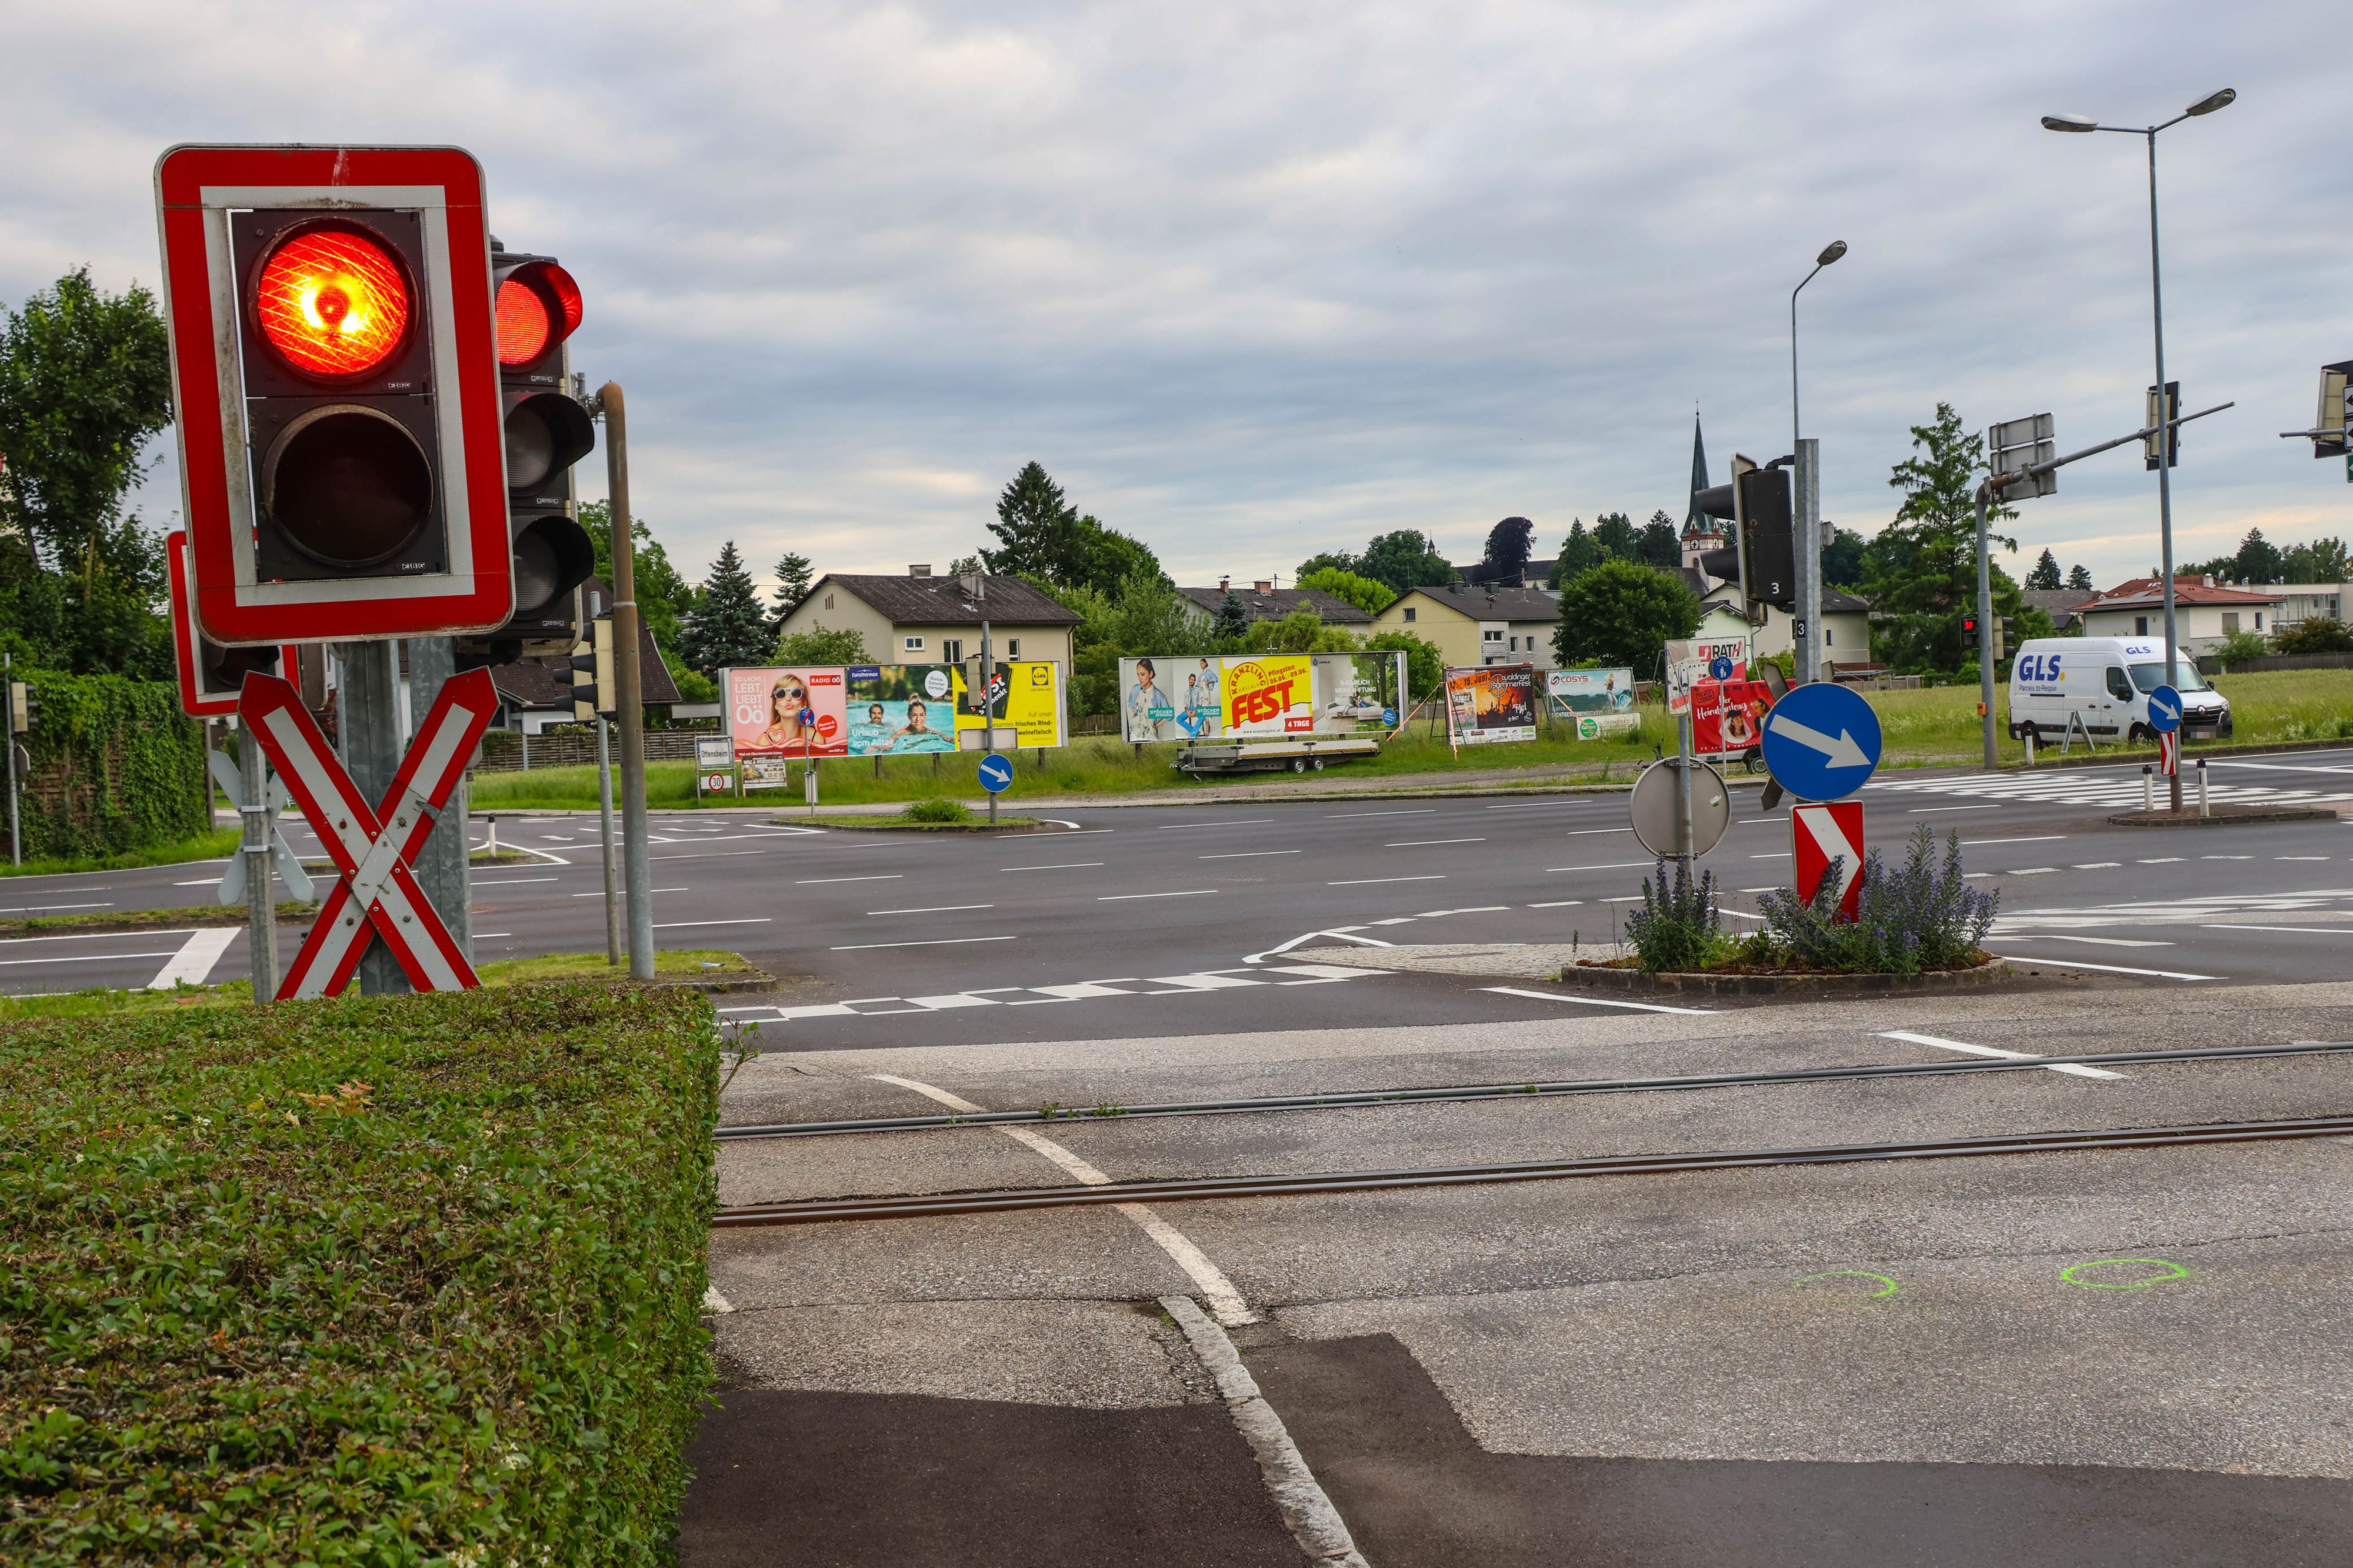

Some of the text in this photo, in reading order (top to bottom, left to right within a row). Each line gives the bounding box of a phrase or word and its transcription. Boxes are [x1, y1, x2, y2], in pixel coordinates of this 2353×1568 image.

[1772, 582, 1779, 594] 3
[1798, 623, 1805, 635] 3
[1712, 642, 1741, 658] RATH
[1268, 665, 1295, 677] Pfingsten
[735, 683, 763, 694] LEBT,
[2041, 685, 2057, 693] People
[736, 695, 763, 704] LIEBT
[1232, 679, 1294, 729] FEST
[736, 705, 765, 725] Oö
[712, 778, 721, 787] 30
